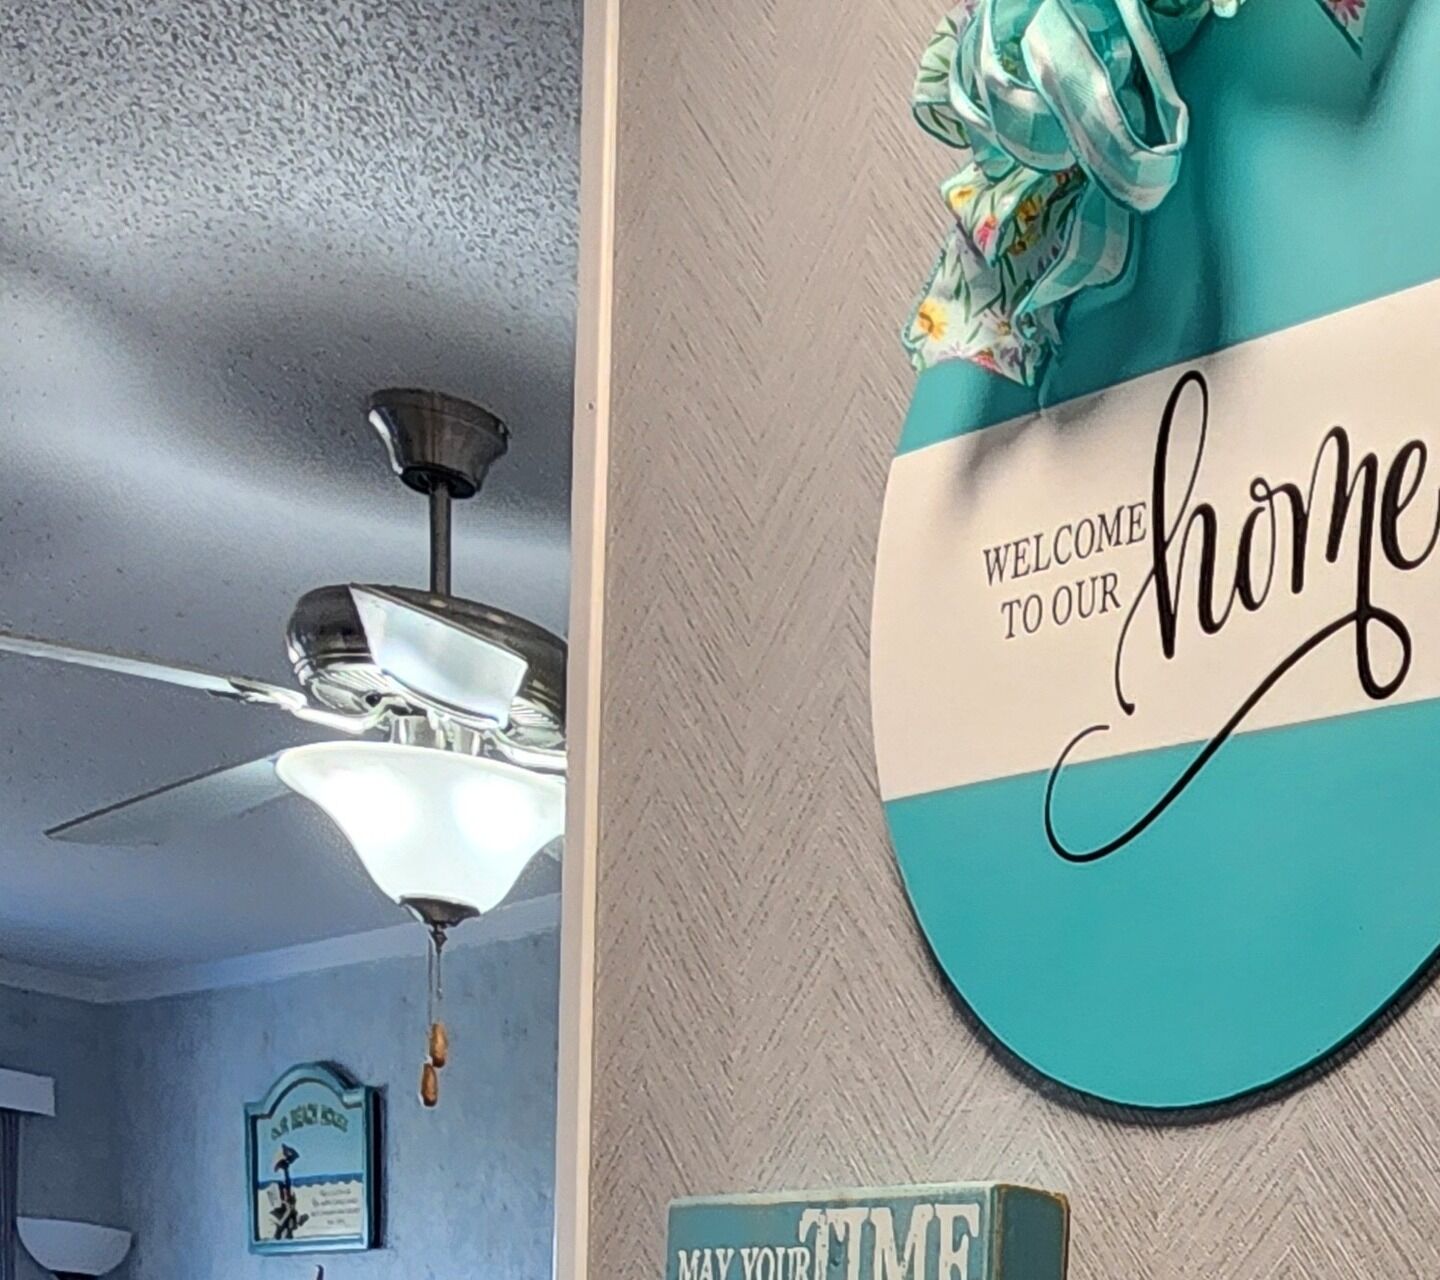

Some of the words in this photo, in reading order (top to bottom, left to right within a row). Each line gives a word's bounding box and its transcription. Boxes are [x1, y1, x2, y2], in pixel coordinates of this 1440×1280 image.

[983, 501, 1147, 587] WELCOME
[1001, 593, 1043, 640] TO
[1052, 572, 1121, 626] OUR
